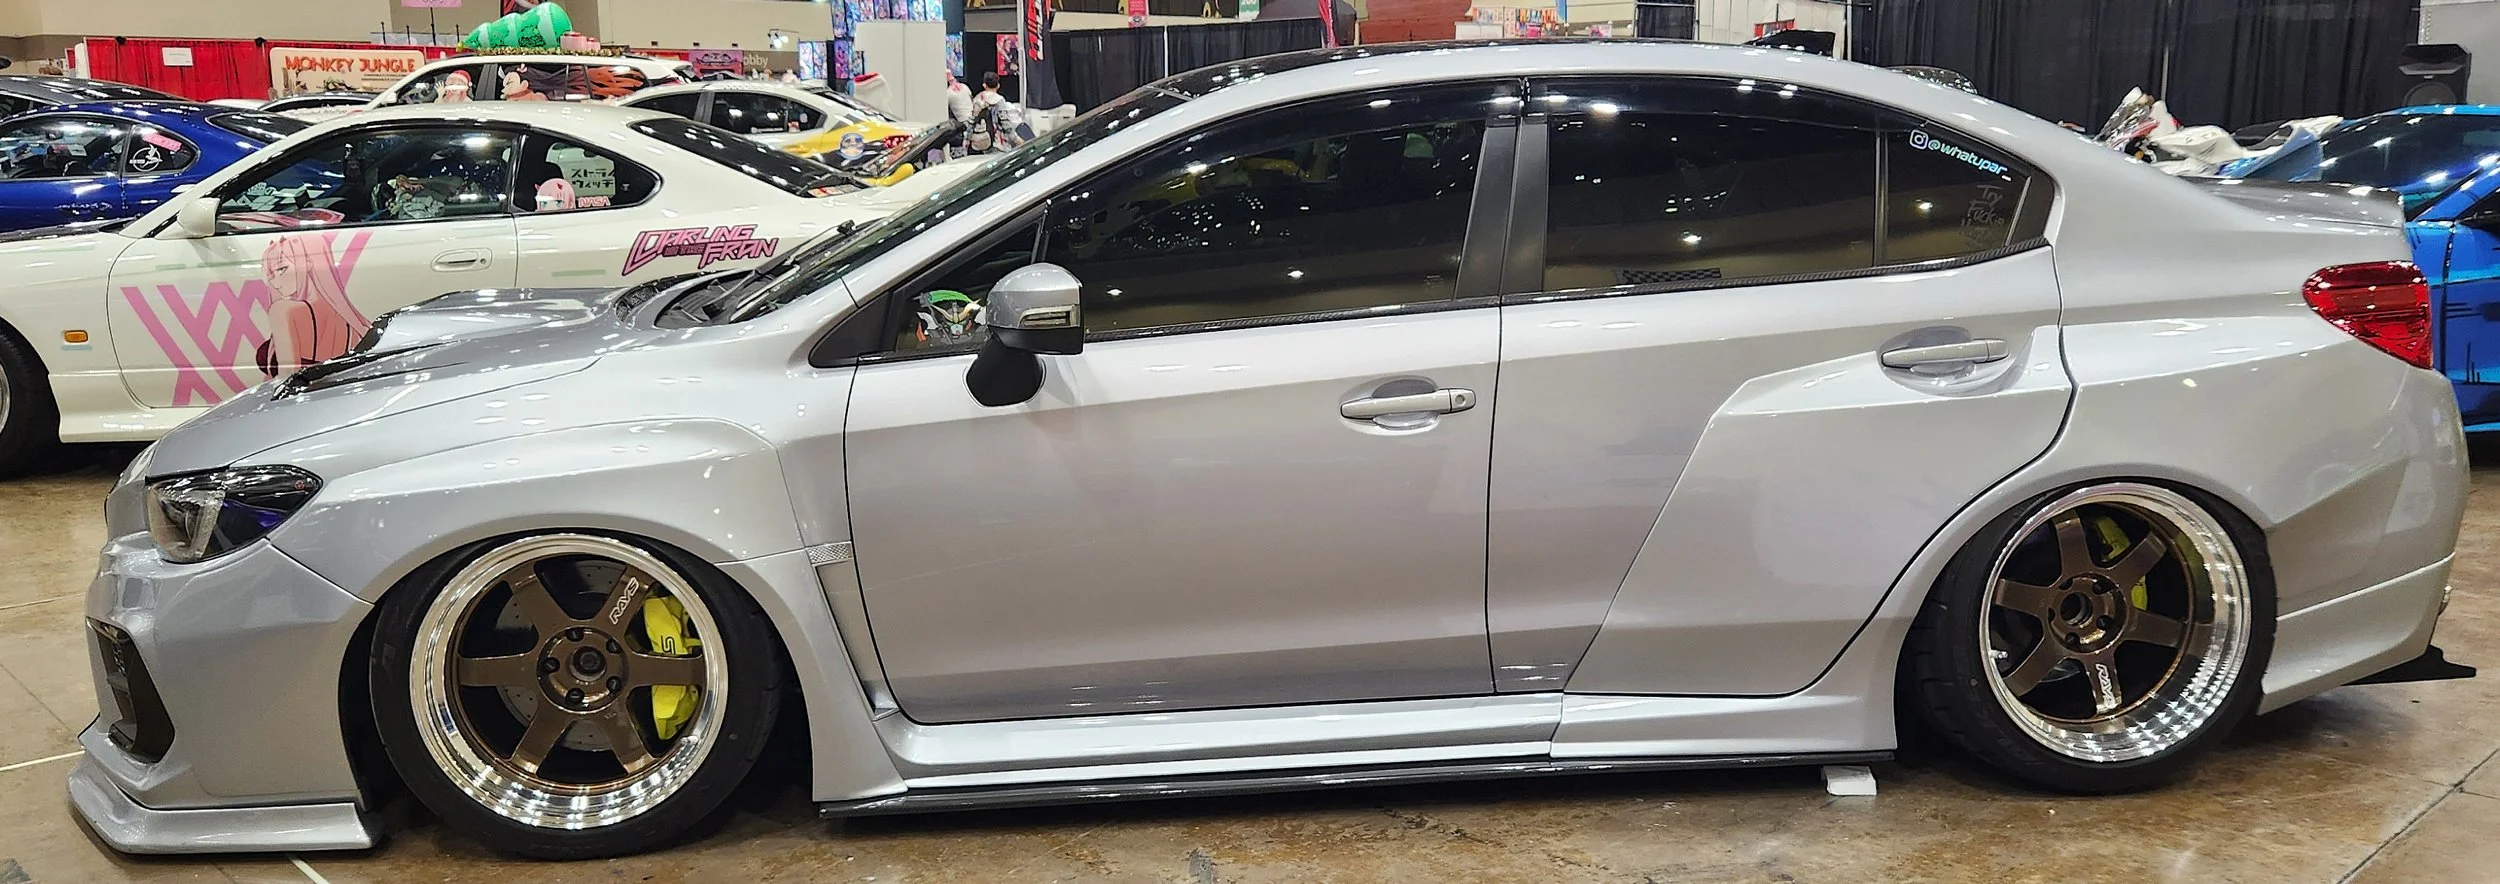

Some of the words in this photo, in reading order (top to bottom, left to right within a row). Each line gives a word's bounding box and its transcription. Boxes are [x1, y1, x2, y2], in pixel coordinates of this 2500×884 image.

[285, 56, 354, 72] MONKEY
[360, 58, 415, 73] JUNGLE
[743, 54, 769, 67] obby
[1928, 139, 2012, 182] @whatupar_
[578, 196, 611, 207] NASA
[622, 224, 758, 276] DARLING
[609, 577, 639, 625] RAYS
